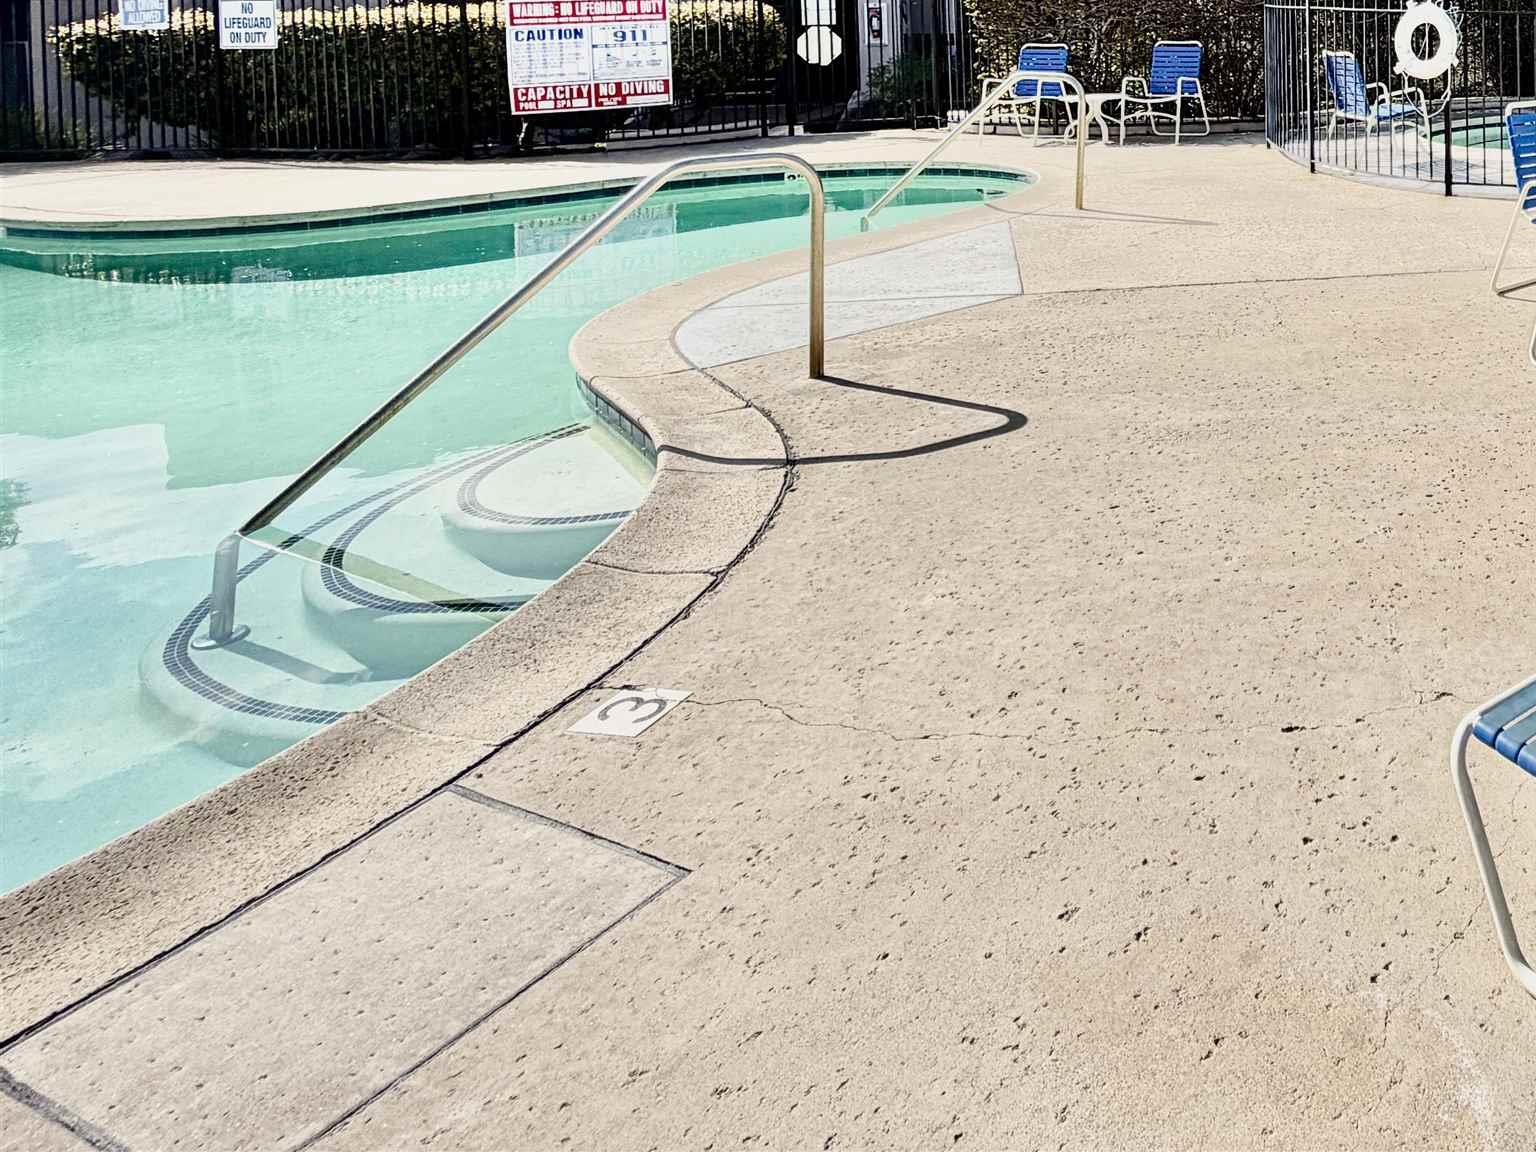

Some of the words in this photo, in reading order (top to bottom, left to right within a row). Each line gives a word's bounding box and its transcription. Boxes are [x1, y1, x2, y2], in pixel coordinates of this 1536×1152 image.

[241, 2, 254, 14] NO
[512, 2, 560, 18] WARNING:
[560, 1, 573, 16] NO
[575, 0, 624, 16] LIFEGUARD
[625, 0, 638, 14] ON
[640, 0, 664, 14] DUTY
[224, 17, 272, 29] LIFEGUARD
[230, 32, 242, 44] ON
[245, 31, 267, 44] DUTY
[515, 28, 584, 42] CAUTION
[613, 29, 648, 42] 911
[517, 85, 590, 101] CAPACITY
[599, 83, 616, 96] NO
[621, 81, 665, 95] DIVING
[519, 101, 537, 110] POOL
[556, 99, 571, 108] SPA
[597, 696, 668, 724] 3
